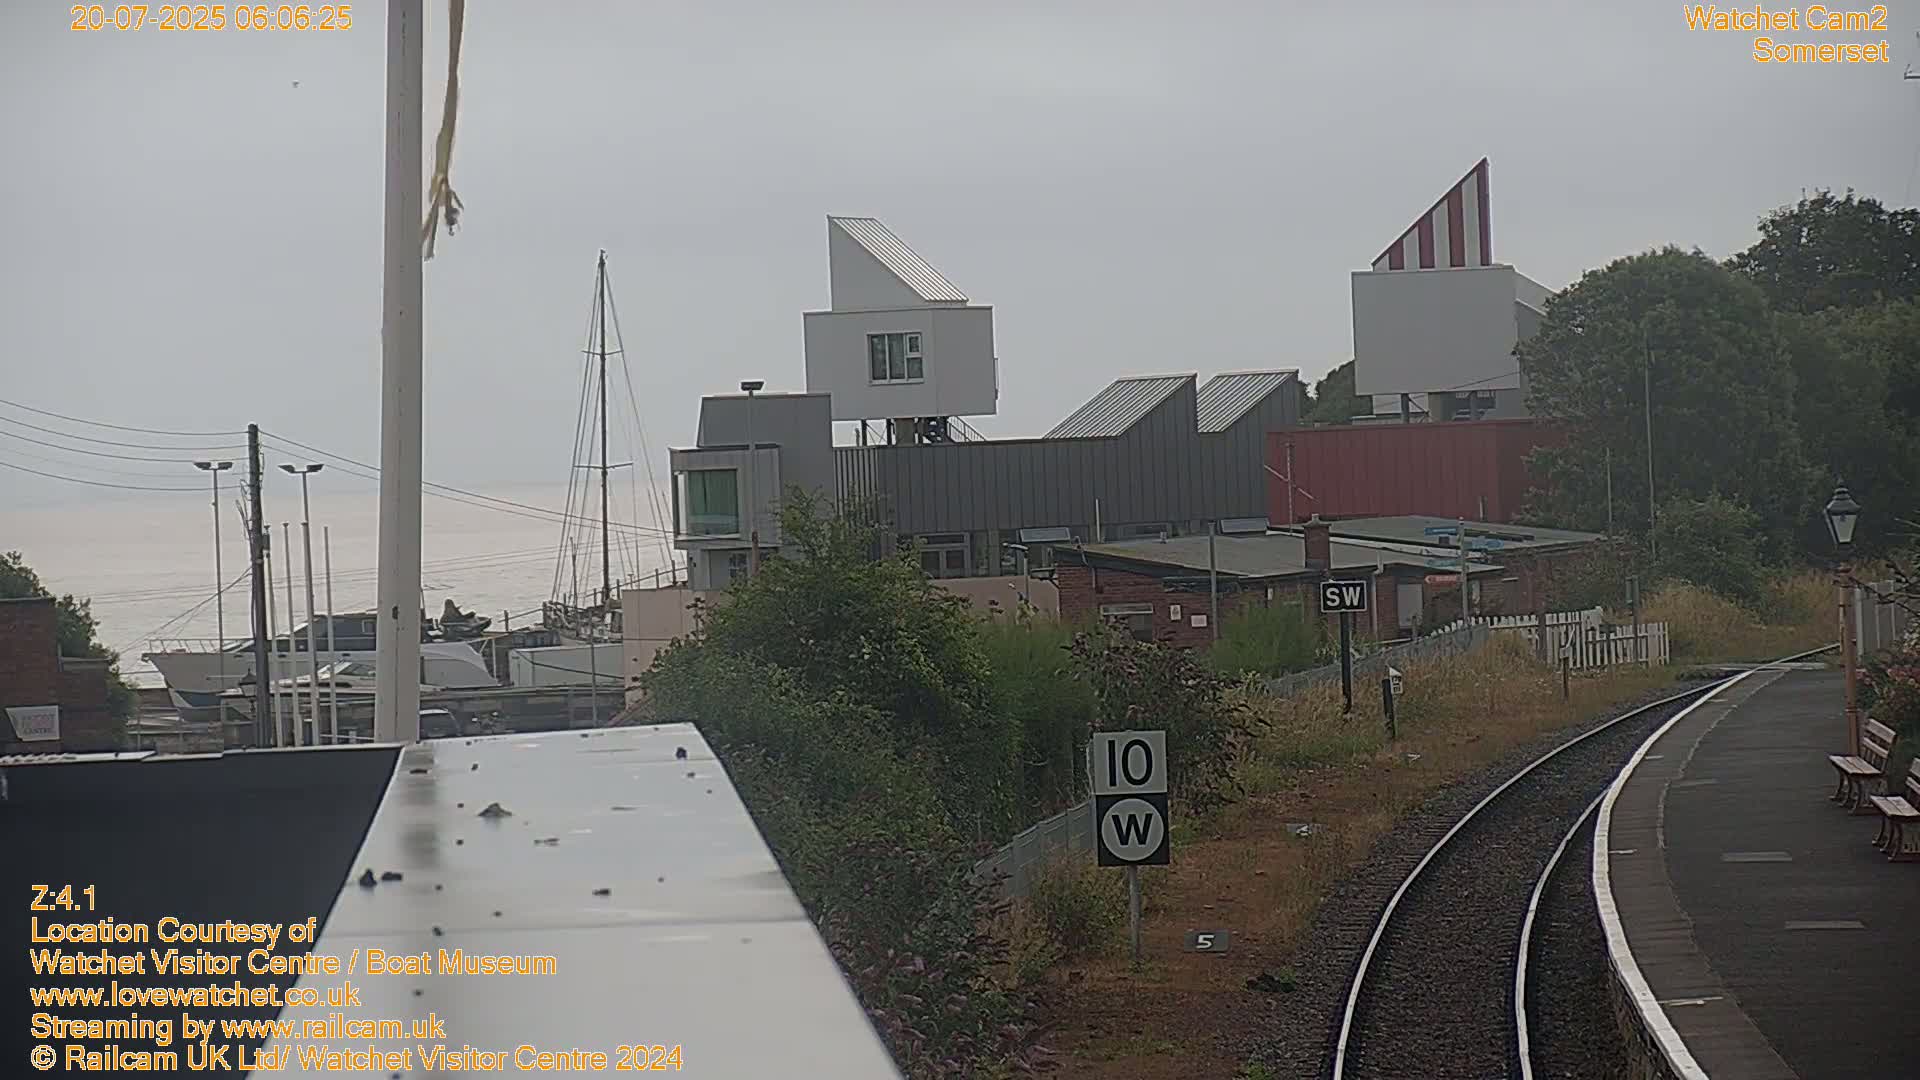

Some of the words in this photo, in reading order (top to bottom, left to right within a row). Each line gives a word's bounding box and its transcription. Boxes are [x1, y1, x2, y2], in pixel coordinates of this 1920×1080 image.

[1326, 586, 1361, 607] SW
[1107, 739, 1153, 787] 10
[1111, 813, 1153, 846] W
[1195, 934, 1215, 950] 5
